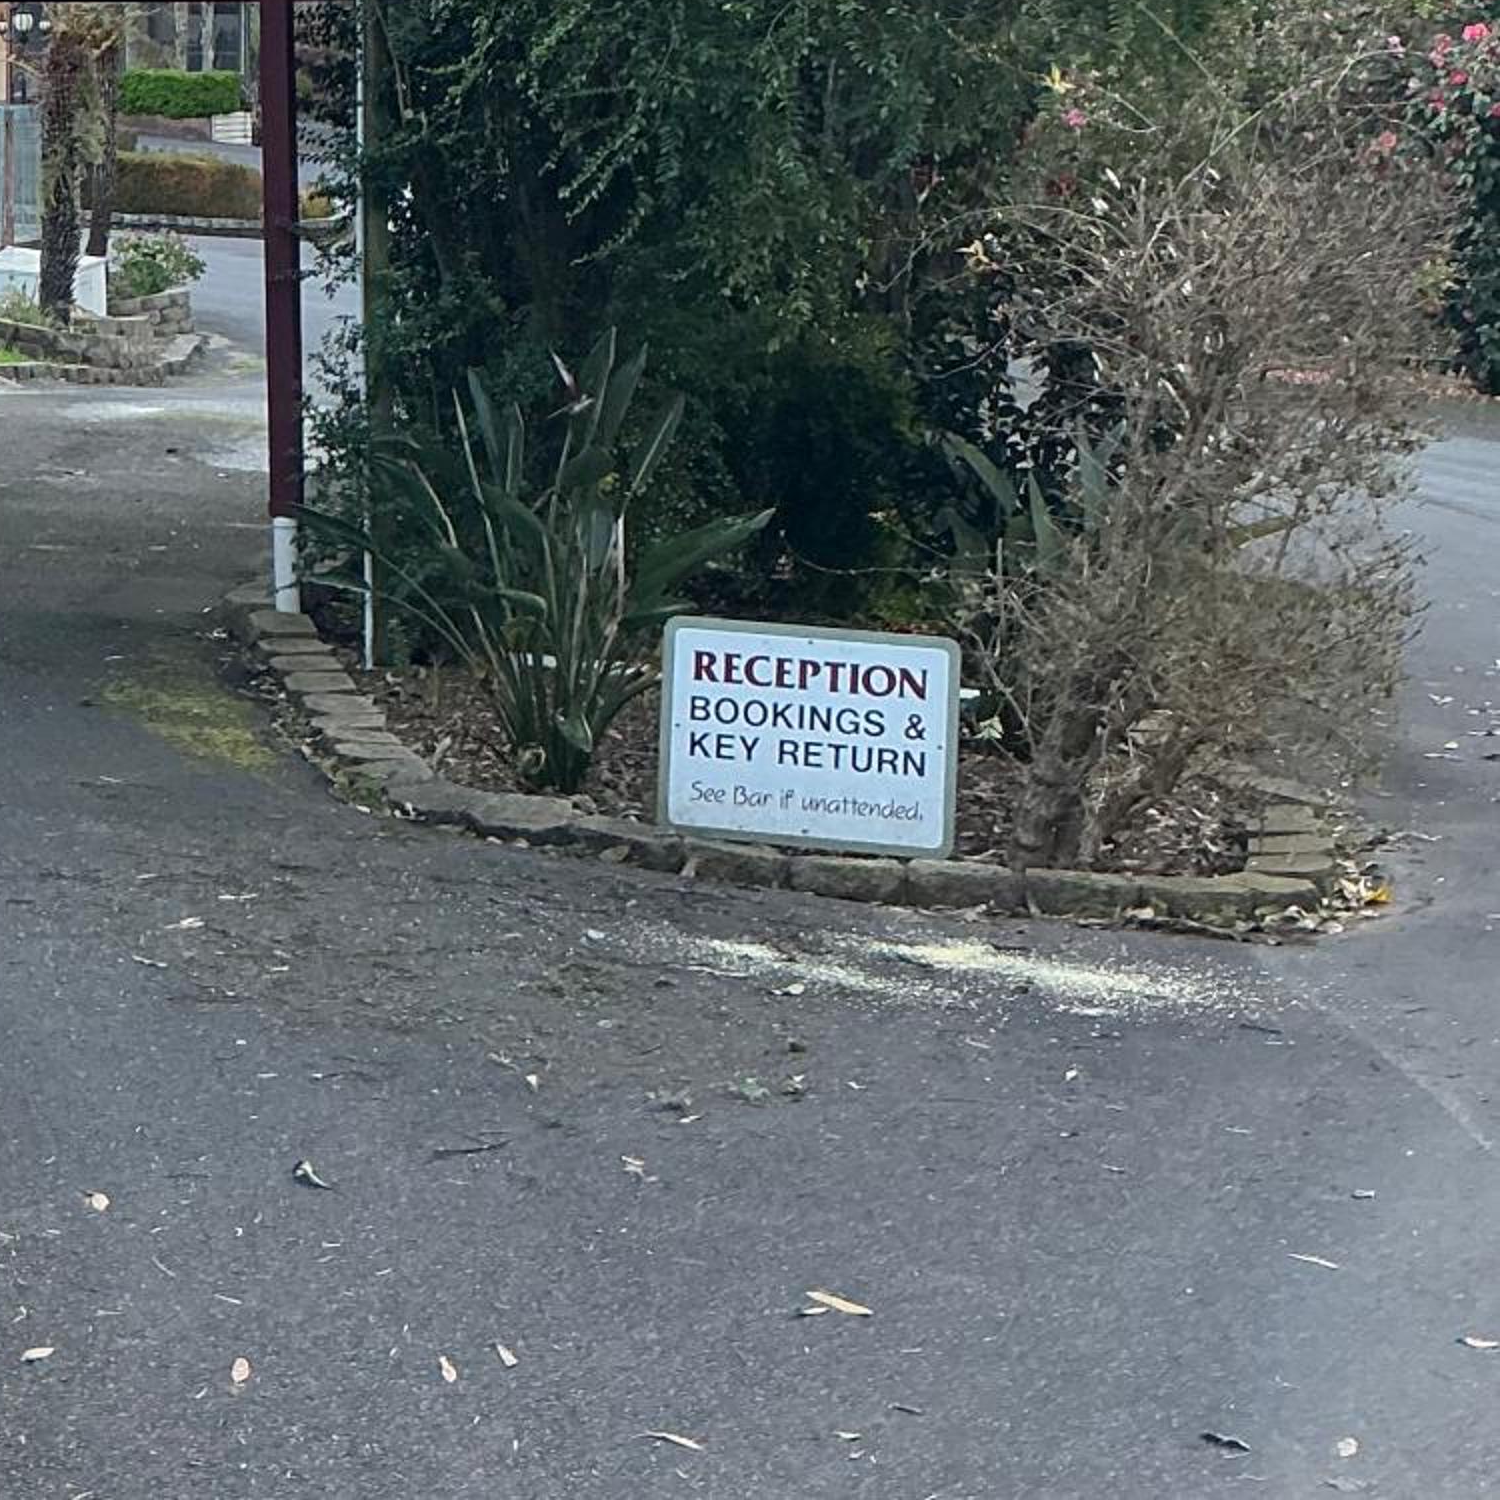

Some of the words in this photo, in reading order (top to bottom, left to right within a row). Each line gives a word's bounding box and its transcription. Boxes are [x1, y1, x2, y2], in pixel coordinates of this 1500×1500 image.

[693, 650, 928, 700] RECEPTION
[690, 696, 885, 737] BOOKINGS
[904, 713, 926, 740] &
[689, 731, 760, 761] KEY
[777, 740, 925, 777] RETURN
[690, 780, 726, 804] See
[733, 785, 772, 806] Bar
[779, 788, 795, 809] if
[801, 796, 923, 820] unattended.
